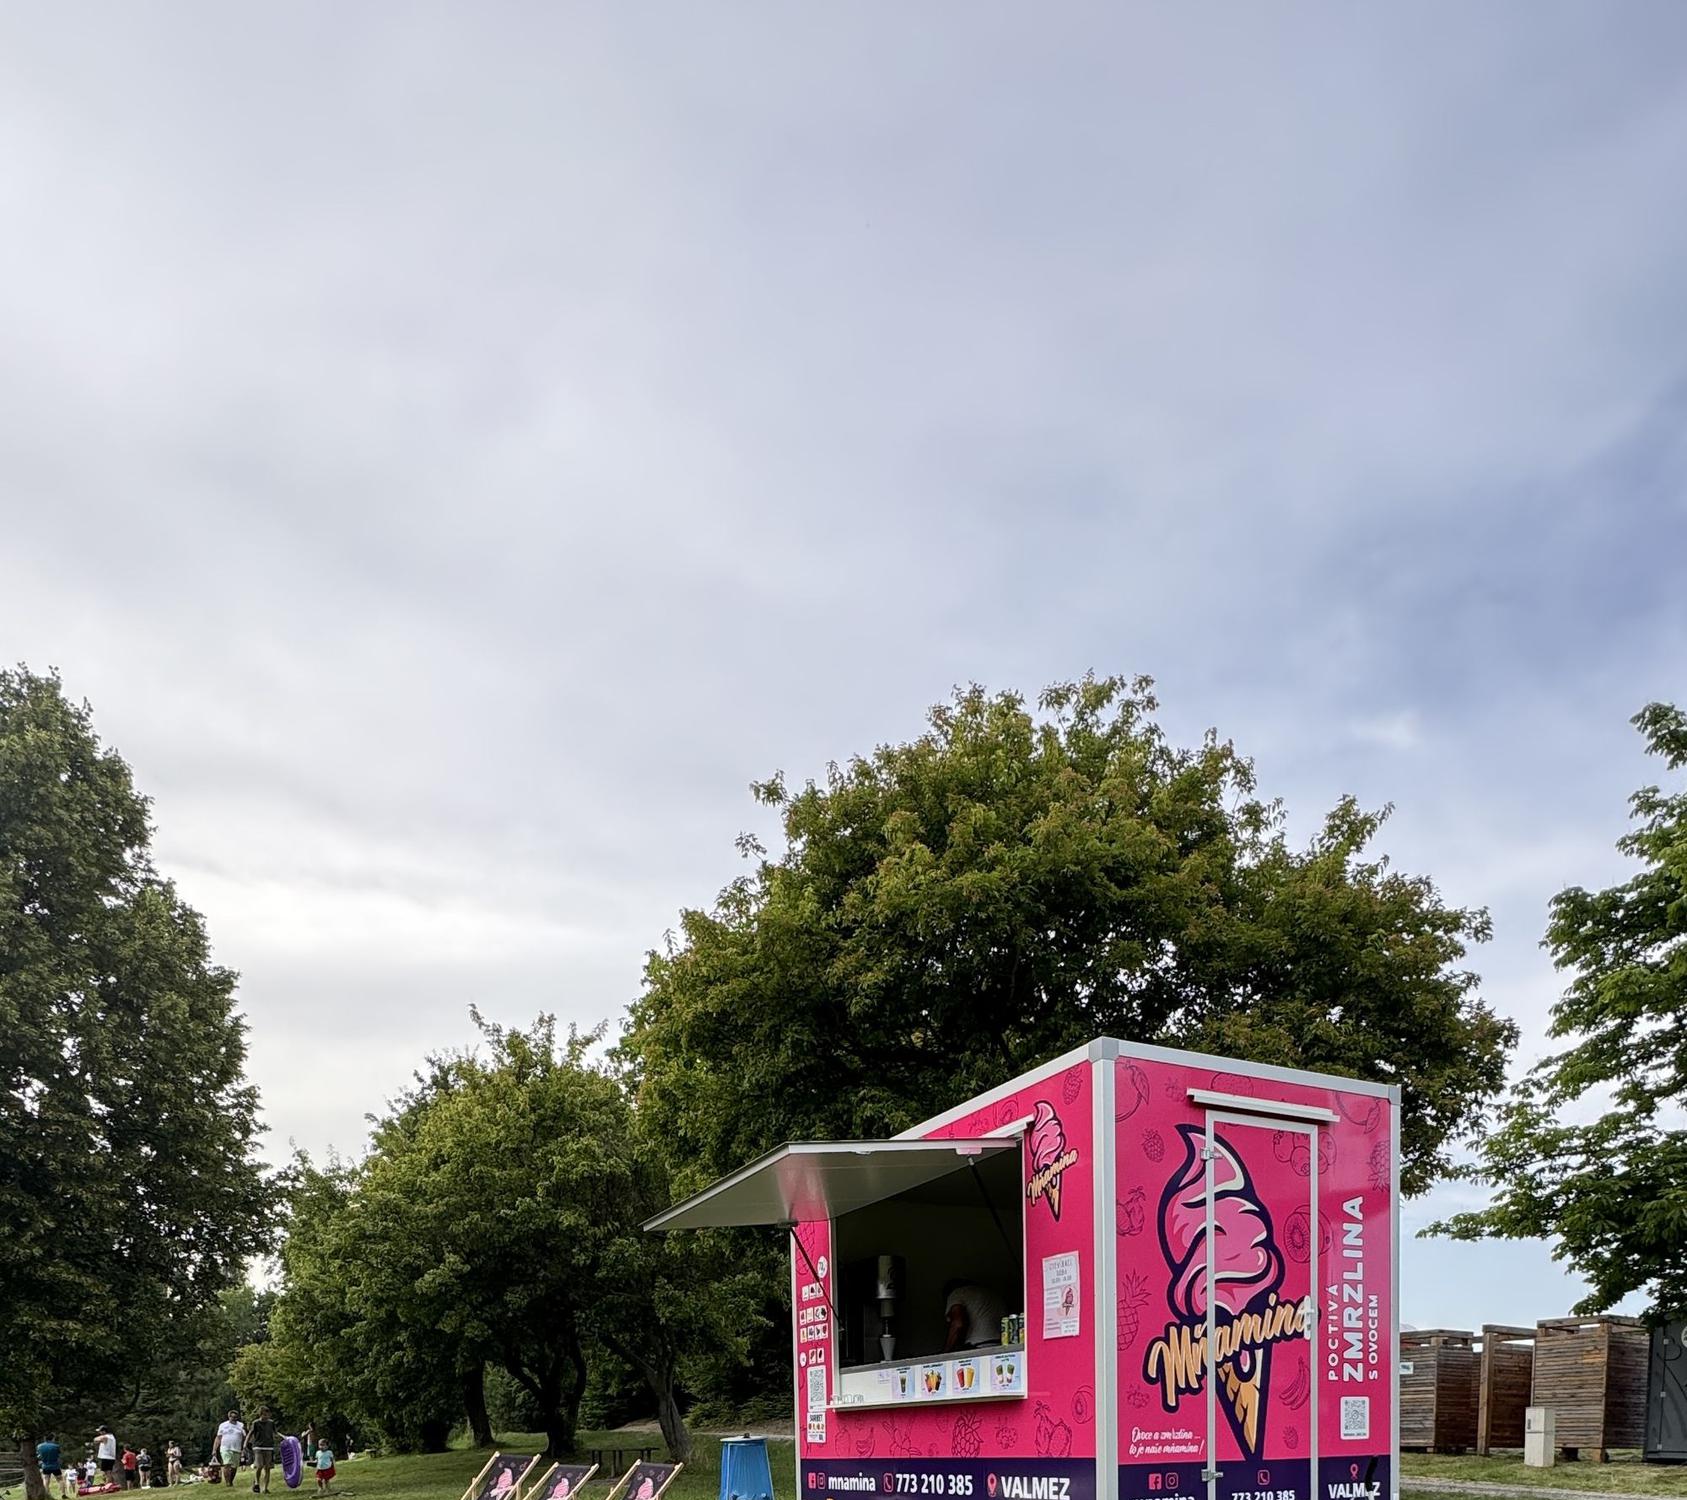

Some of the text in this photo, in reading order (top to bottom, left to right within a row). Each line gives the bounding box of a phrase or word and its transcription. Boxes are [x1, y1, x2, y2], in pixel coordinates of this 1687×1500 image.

[1326, 1284, 1338, 1381] POCTIVÁ
[1343, 1196, 1364, 1383] ZMRZLINA
[1369, 1294, 1378, 1380] S OVOCEM
[828, 1472, 1070, 1500] mnamina 773 210 385 VALMEZ
